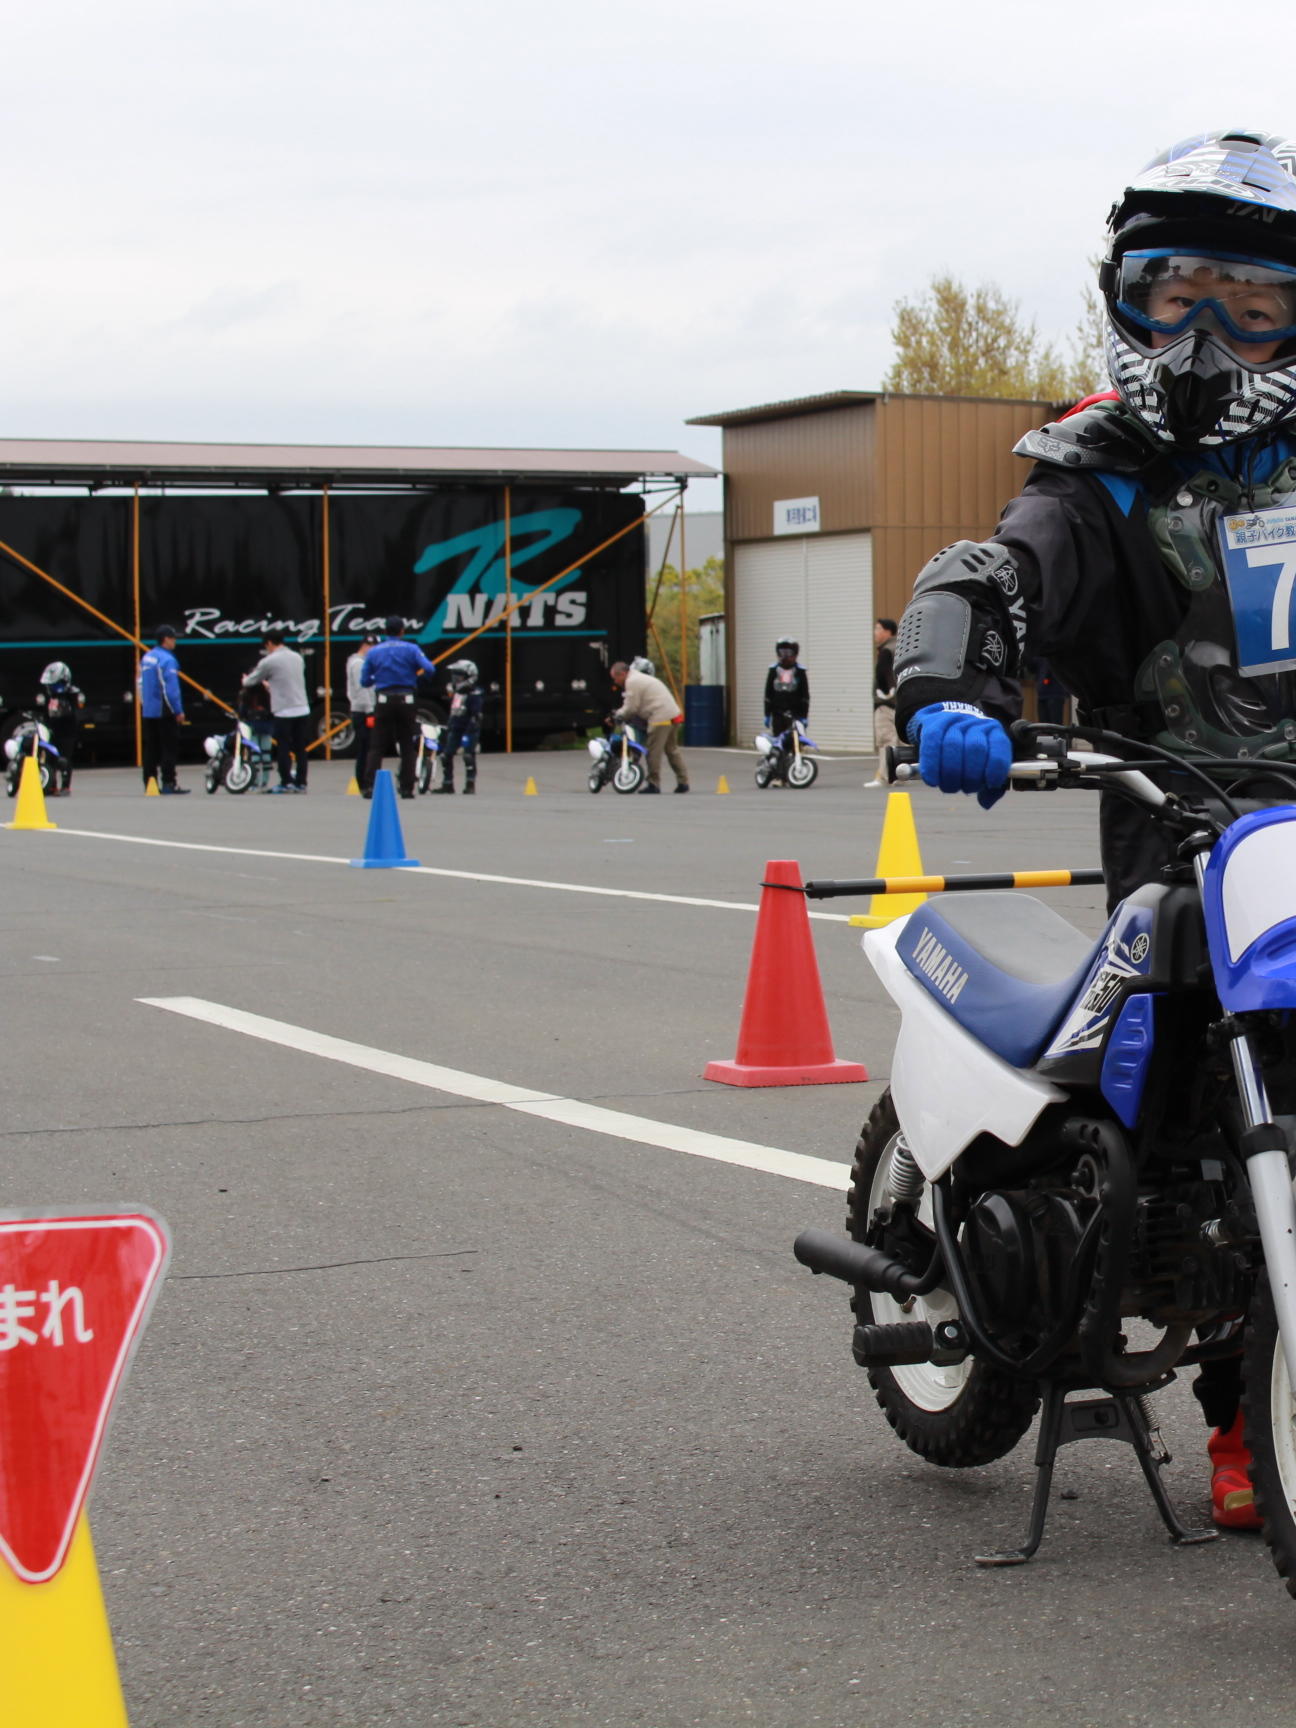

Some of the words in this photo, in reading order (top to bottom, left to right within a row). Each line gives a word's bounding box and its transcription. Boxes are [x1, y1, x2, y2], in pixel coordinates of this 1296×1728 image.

[184, 607, 321, 643] Racing
[443, 591, 587, 629] NATS
[911, 926, 969, 1005] YAMAHA
[0, 1279, 95, 1351] まれ
